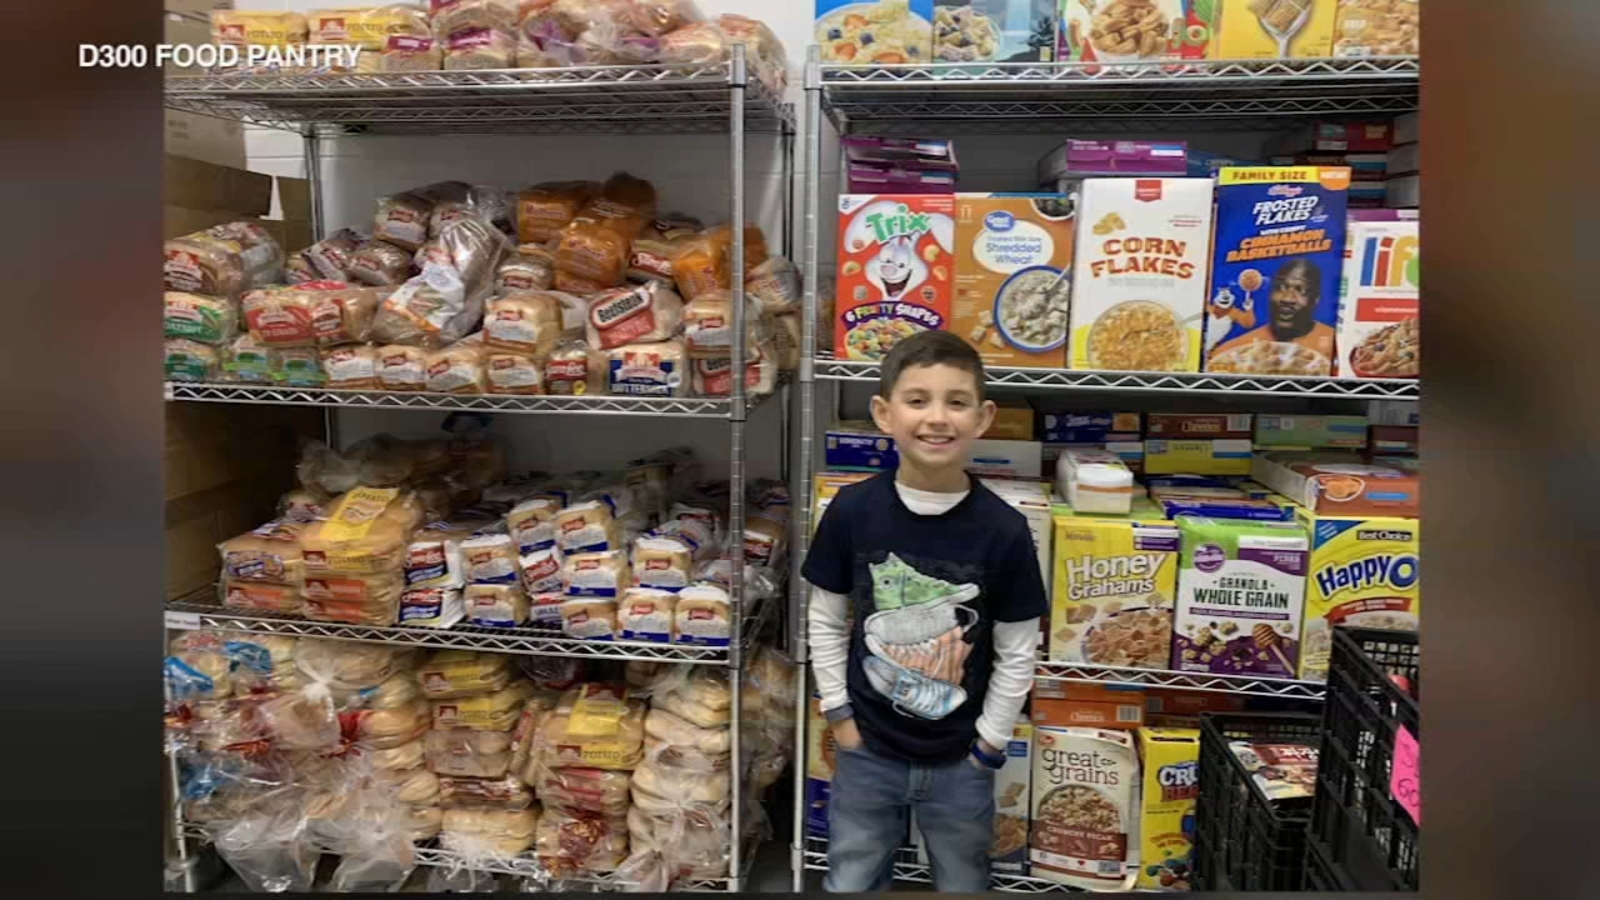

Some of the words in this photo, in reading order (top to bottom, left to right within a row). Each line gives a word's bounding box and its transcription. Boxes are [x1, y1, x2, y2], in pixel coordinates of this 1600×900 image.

[1232, 172, 1276, 181] FAMILY
[1279, 171, 1308, 180] SIZE
[1253, 196, 1319, 215] FROSTED
[866, 206, 930, 243] Trix
[1255, 209, 1311, 226] FLAKES
[986, 242, 1042, 254] Shredded
[1103, 237, 1187, 257] CORN
[1240, 229, 1326, 249] CINNAMON
[995, 254, 1031, 265] Wheat
[1226, 239, 1332, 263] BASKETBALLS
[1090, 256, 1195, 280] FLAKES
[1359, 531, 1378, 540] Best
[1379, 531, 1412, 541] Choice
[1066, 552, 1166, 584] Honey
[1069, 578, 1154, 601] Grahams
[1219, 577, 1268, 591] GRANOLA
[1193, 587, 1242, 606] WHOLE
[1245, 591, 1290, 609] GRAIN
[1042, 748, 1103, 770] great
[1050, 767, 1119, 785] grains
